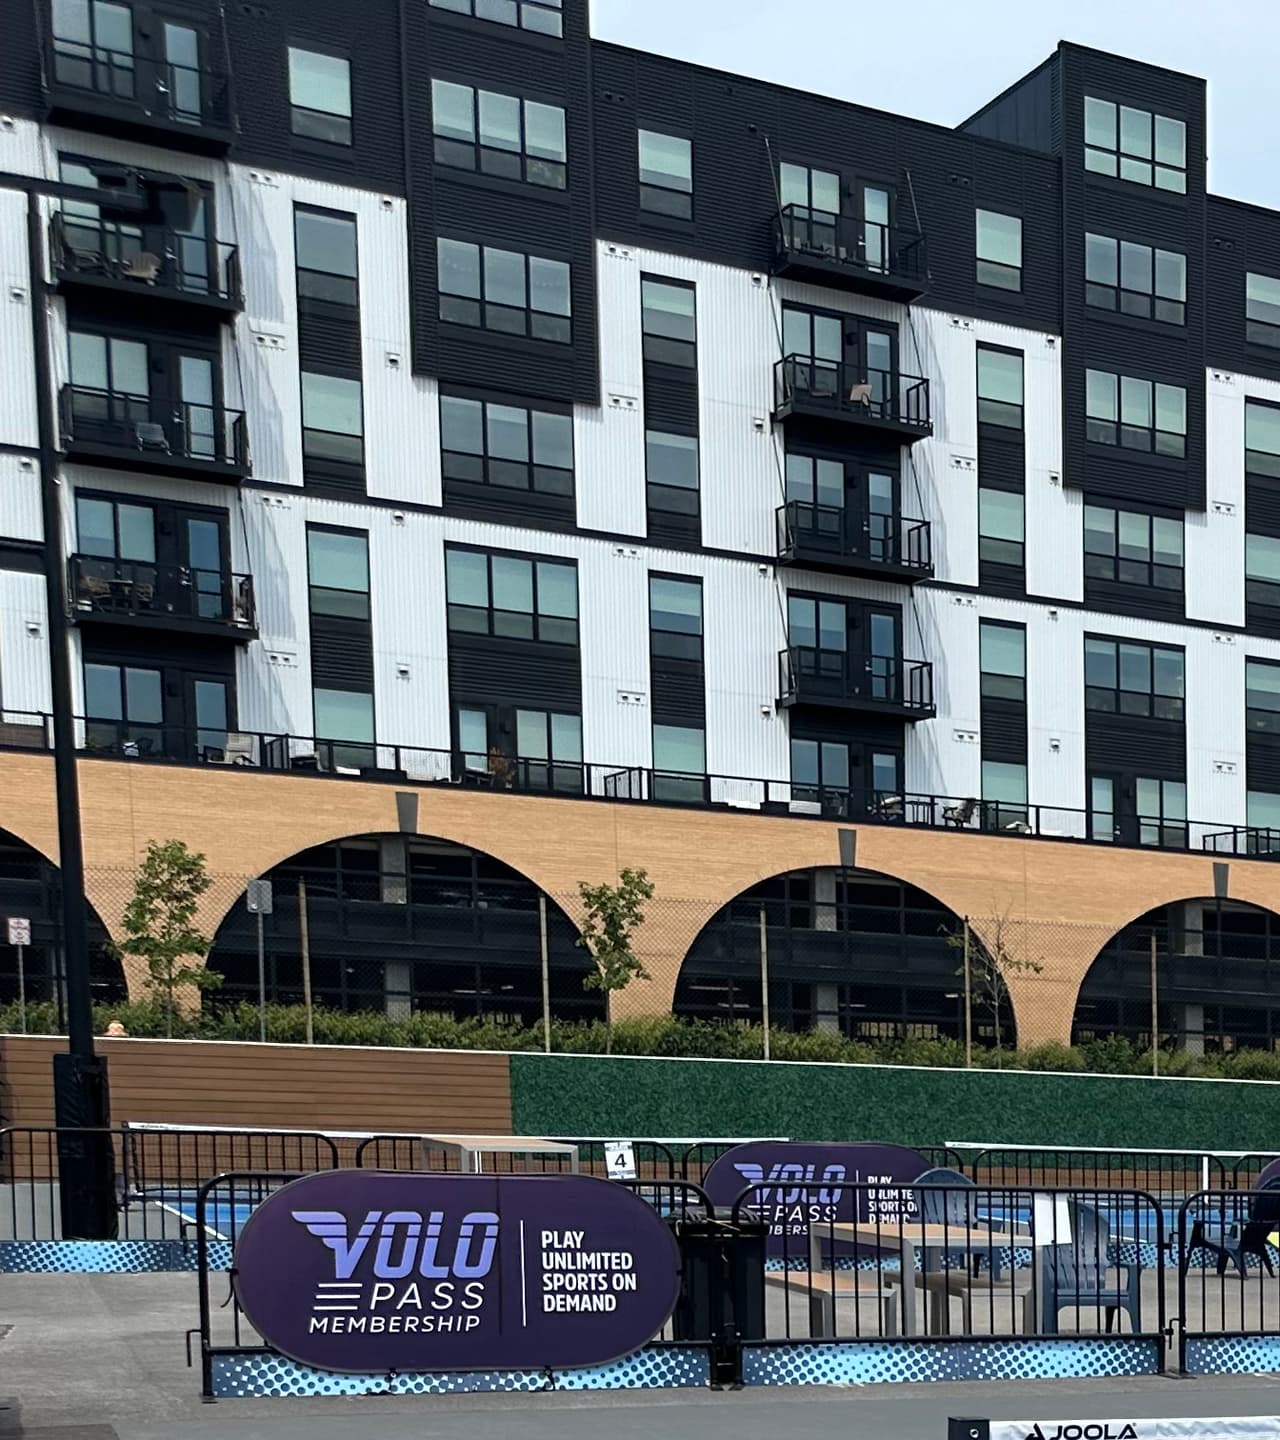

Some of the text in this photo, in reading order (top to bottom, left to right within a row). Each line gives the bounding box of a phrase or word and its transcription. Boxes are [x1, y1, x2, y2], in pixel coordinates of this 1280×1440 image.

[615, 1153, 627, 1168] 4
[734, 1164, 846, 1204] VOLO
[774, 1205, 837, 1222] PASS
[291, 1211, 499, 1279] VOLO
[541, 1230, 584, 1249] PLAY
[542, 1252, 633, 1270] UNLIMITED
[542, 1273, 636, 1291] SPORTS ON
[370, 1282, 485, 1310] PASS
[543, 1294, 617, 1312] DEMAND
[309, 1315, 480, 1334] MEMBERSHIP
